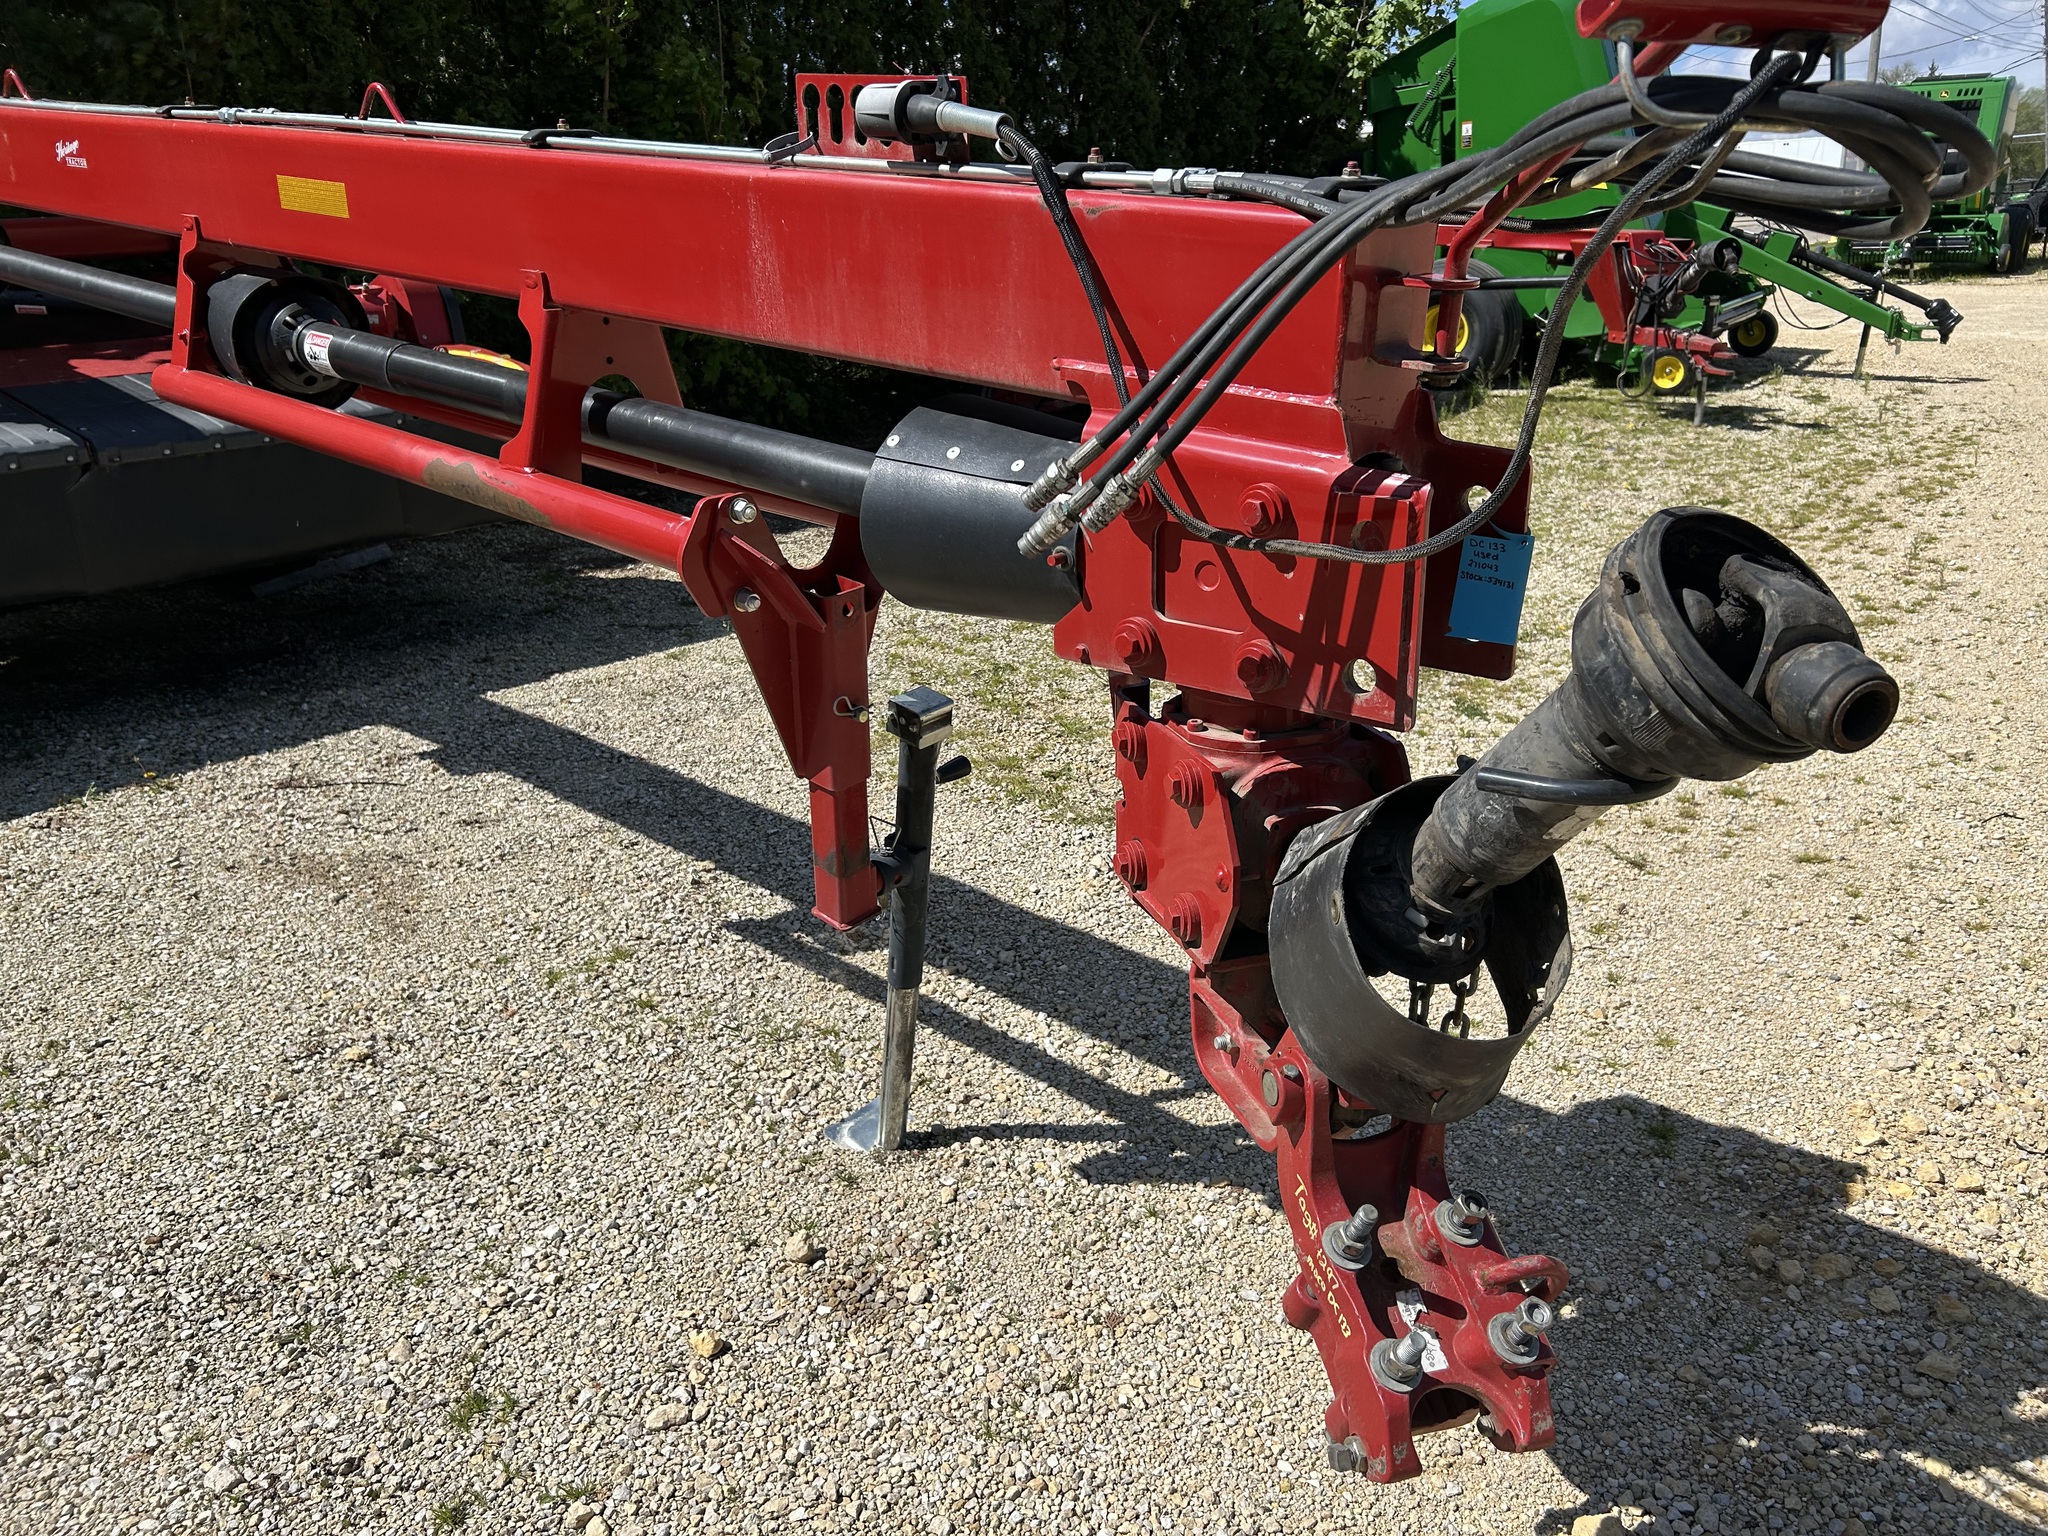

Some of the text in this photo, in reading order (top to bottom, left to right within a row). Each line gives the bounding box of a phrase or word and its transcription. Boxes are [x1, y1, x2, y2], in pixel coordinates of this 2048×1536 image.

[55, 139, 79, 162] Heritage
[1469, 538, 1506, 552] DC 133
[1467, 559, 1499, 572] 271043
[1294, 1173, 1318, 1240] Tag#
[1327, 1290, 1340, 1316] DC
[1338, 1313, 1352, 1338] 133
